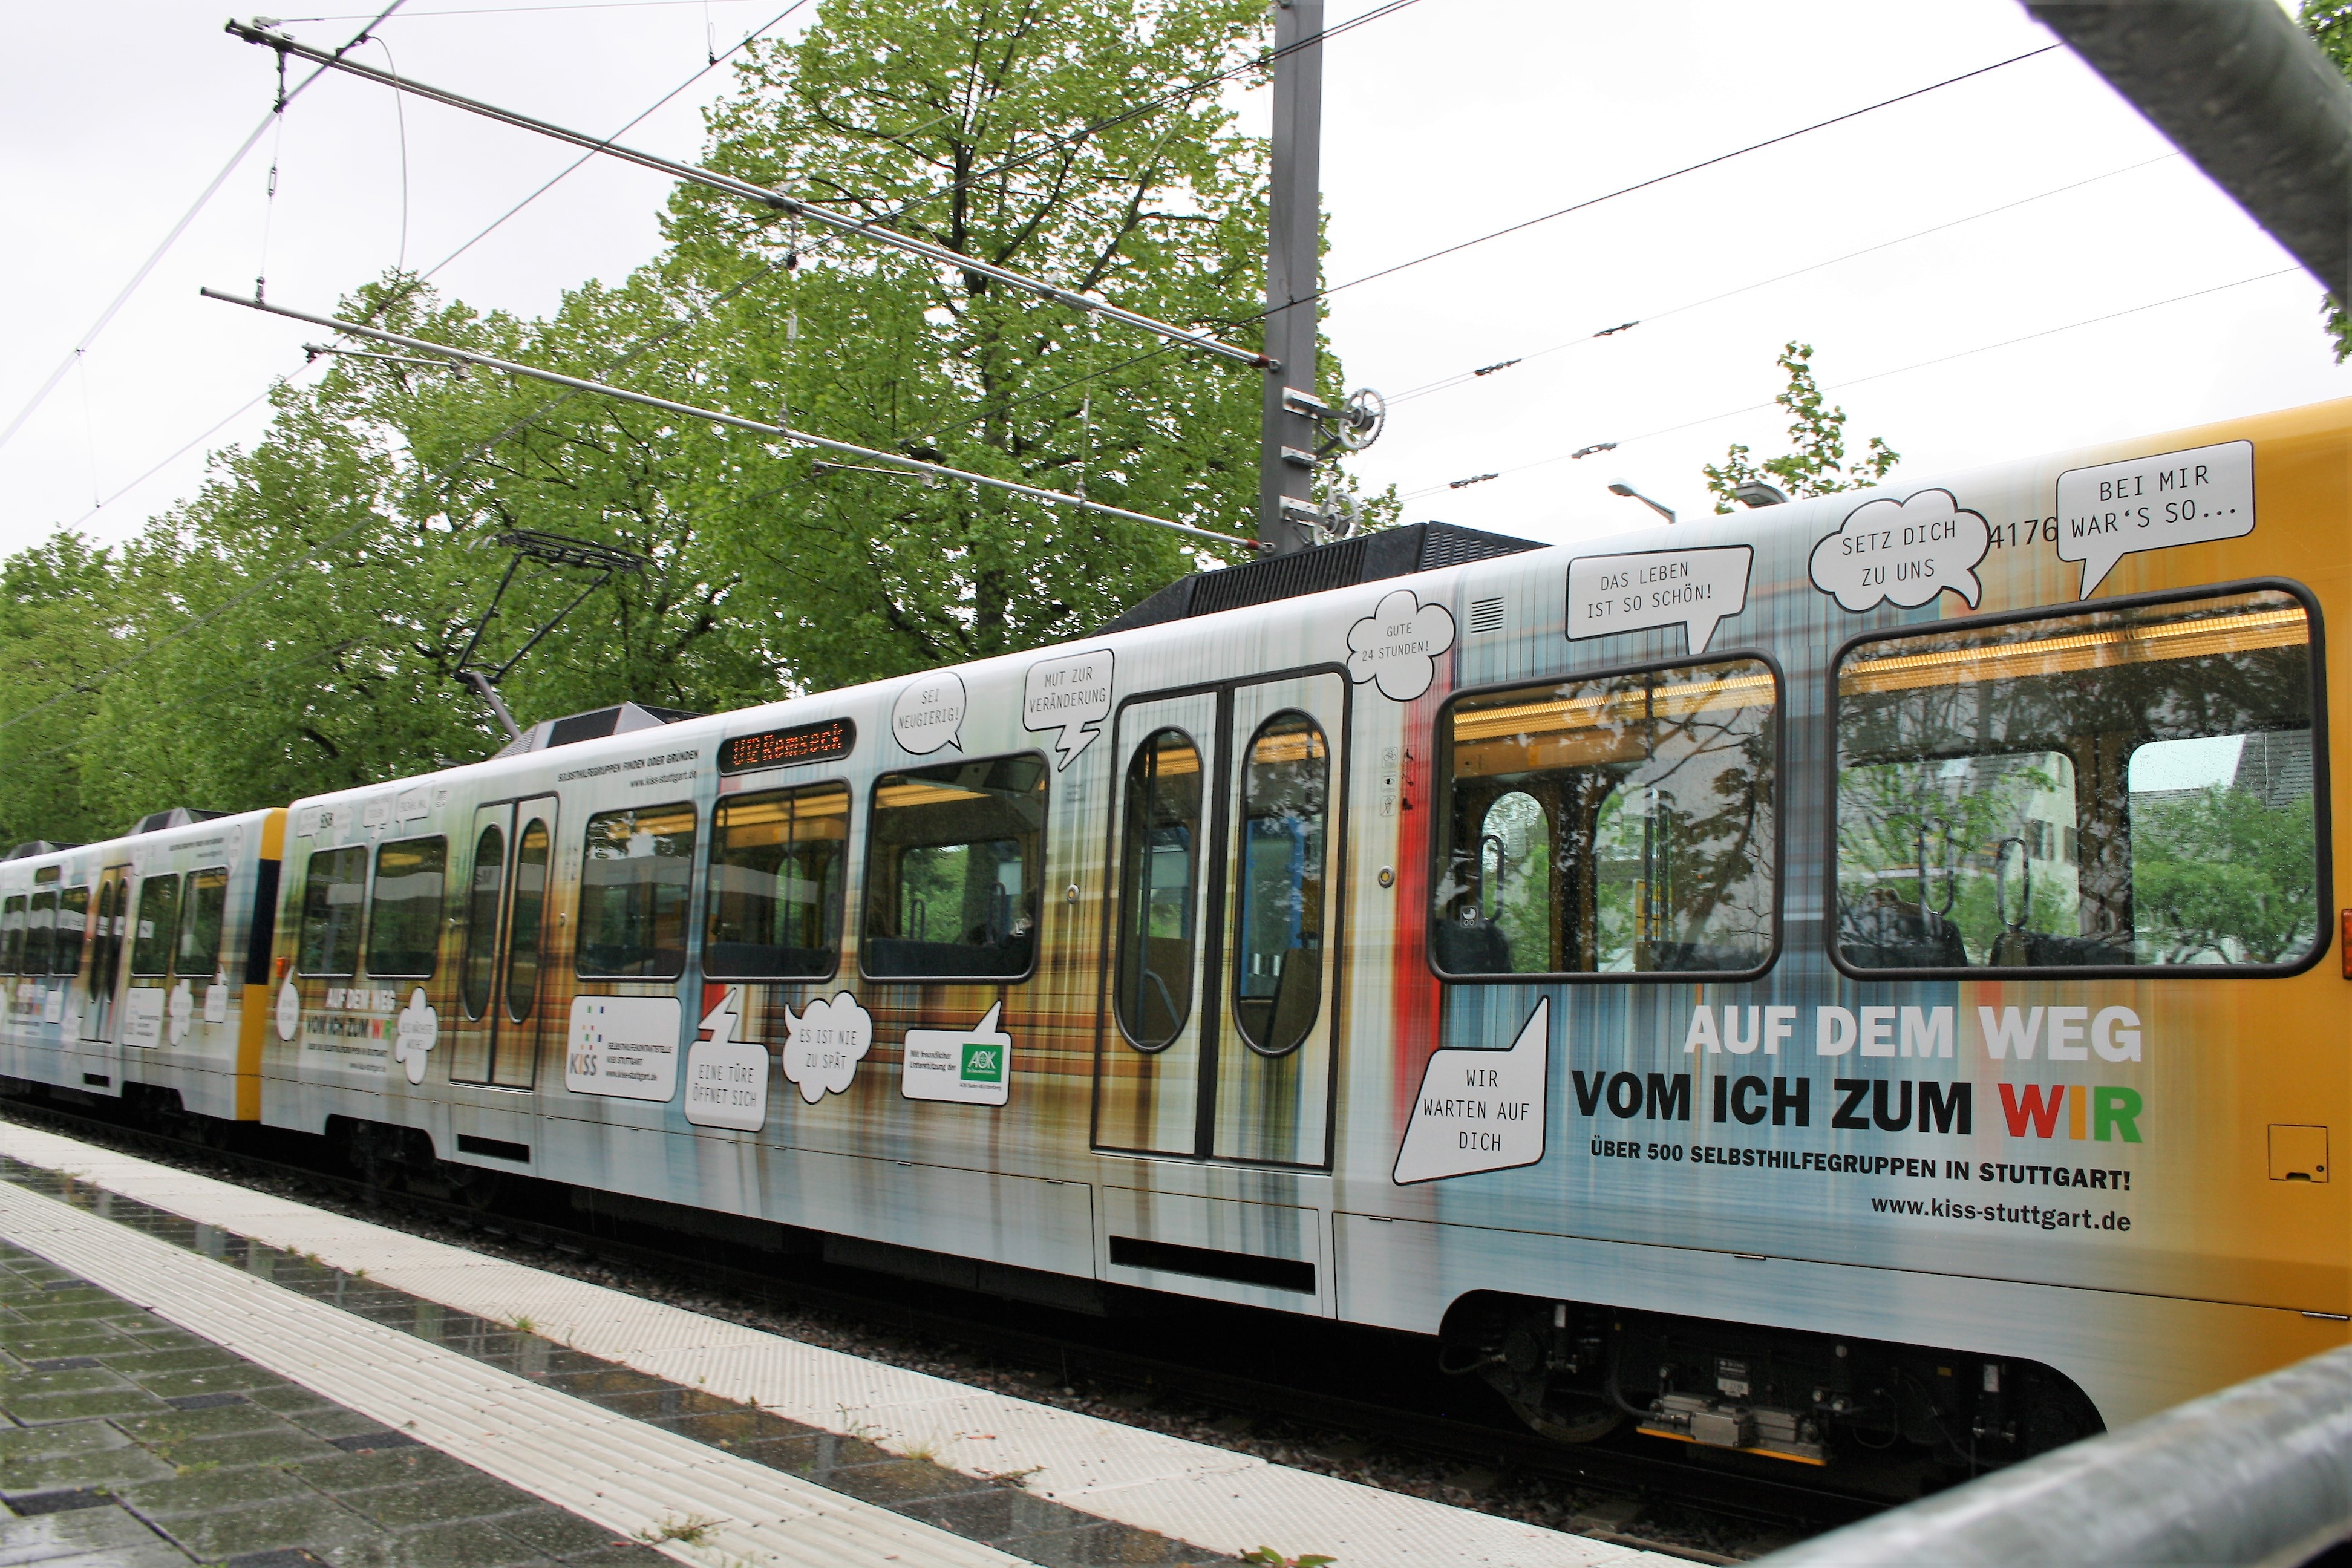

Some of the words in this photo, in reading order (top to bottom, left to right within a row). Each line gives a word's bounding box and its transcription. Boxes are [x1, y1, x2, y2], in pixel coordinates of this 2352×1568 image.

[2100, 475, 2143, 501] BEI
[2160, 465, 2209, 492] MIR
[2165, 500, 2236, 523] SO...
[1842, 529, 1892, 555] SETZ
[1904, 520, 1956, 546] DICH
[1990, 516, 2058, 549] 4176
[1601, 572, 1629, 591] DAS
[1639, 561, 1690, 585] LEBEN
[1862, 566, 1885, 587] ZU
[1896, 558, 1935, 581] UNS
[1587, 603, 1614, 619] IST
[1624, 595, 1642, 612] SO
[1652, 583, 1711, 608] SCHÖN!
[1387, 622, 1413, 637] GUTE
[1362, 649, 1374, 662] 24
[1379, 640, 1429, 659] STUNDEN!
[1045, 671, 1066, 688] MUT
[1071, 666, 1093, 683] ZUR
[921, 688, 939, 705] SEI
[1030, 687, 1106, 713] VERÄNDERUNG
[898, 707, 959, 729] NEUGIERIG!
[762, 722, 844, 761] Remseck
[558, 763, 621, 782] SELBSTHILFEGRUPPEN
[623, 759, 645, 771] FINDEN
[647, 754, 665, 768] ODER
[667, 749, 699, 764] GRÜNDEN
[630, 769, 697, 788] www.kiss-stuttgart.de
[371, 990, 396, 1012] WEG
[800, 1028, 812, 1043] ES
[817, 1029, 834, 1045] IST
[838, 1030, 857, 1045] NIE
[1684, 1005, 1796, 1054] AUF
[1815, 1005, 1953, 1059] DEM
[1978, 1005, 2142, 1062] WEG
[569, 1053, 598, 1076] KISS
[806, 1053, 818, 1068] ZU
[823, 1051, 847, 1070] SPÄT
[967, 1050, 997, 1070] AOK
[699, 1063, 724, 1081] EINE
[728, 1063, 755, 1083] TÜRE
[1466, 1069, 1498, 1088] WIR
[693, 1082, 729, 1104] ÖFFNET
[732, 1089, 757, 1108] SICH
[1424, 1098, 1487, 1119] WARTEN
[1497, 1102, 1530, 1121] AUF
[1571, 1070, 1691, 1122] VOM
[1713, 1075, 1811, 1128] ICH
[1831, 1079, 1972, 1135] ZUM
[1997, 1083, 2143, 1144] WIR
[1459, 1132, 1501, 1152] DICH
[1591, 1135, 1642, 1159] ÜBER
[1647, 1143, 1684, 1162] 500
[1690, 1146, 1936, 1178] SELBSTHILFEGRUPPEN
[1945, 1160, 1970, 1180] IN
[1979, 1163, 2131, 1191] STUTTGART!
[1871, 1198, 2132, 1232] www.kiss-stuttgart.de
